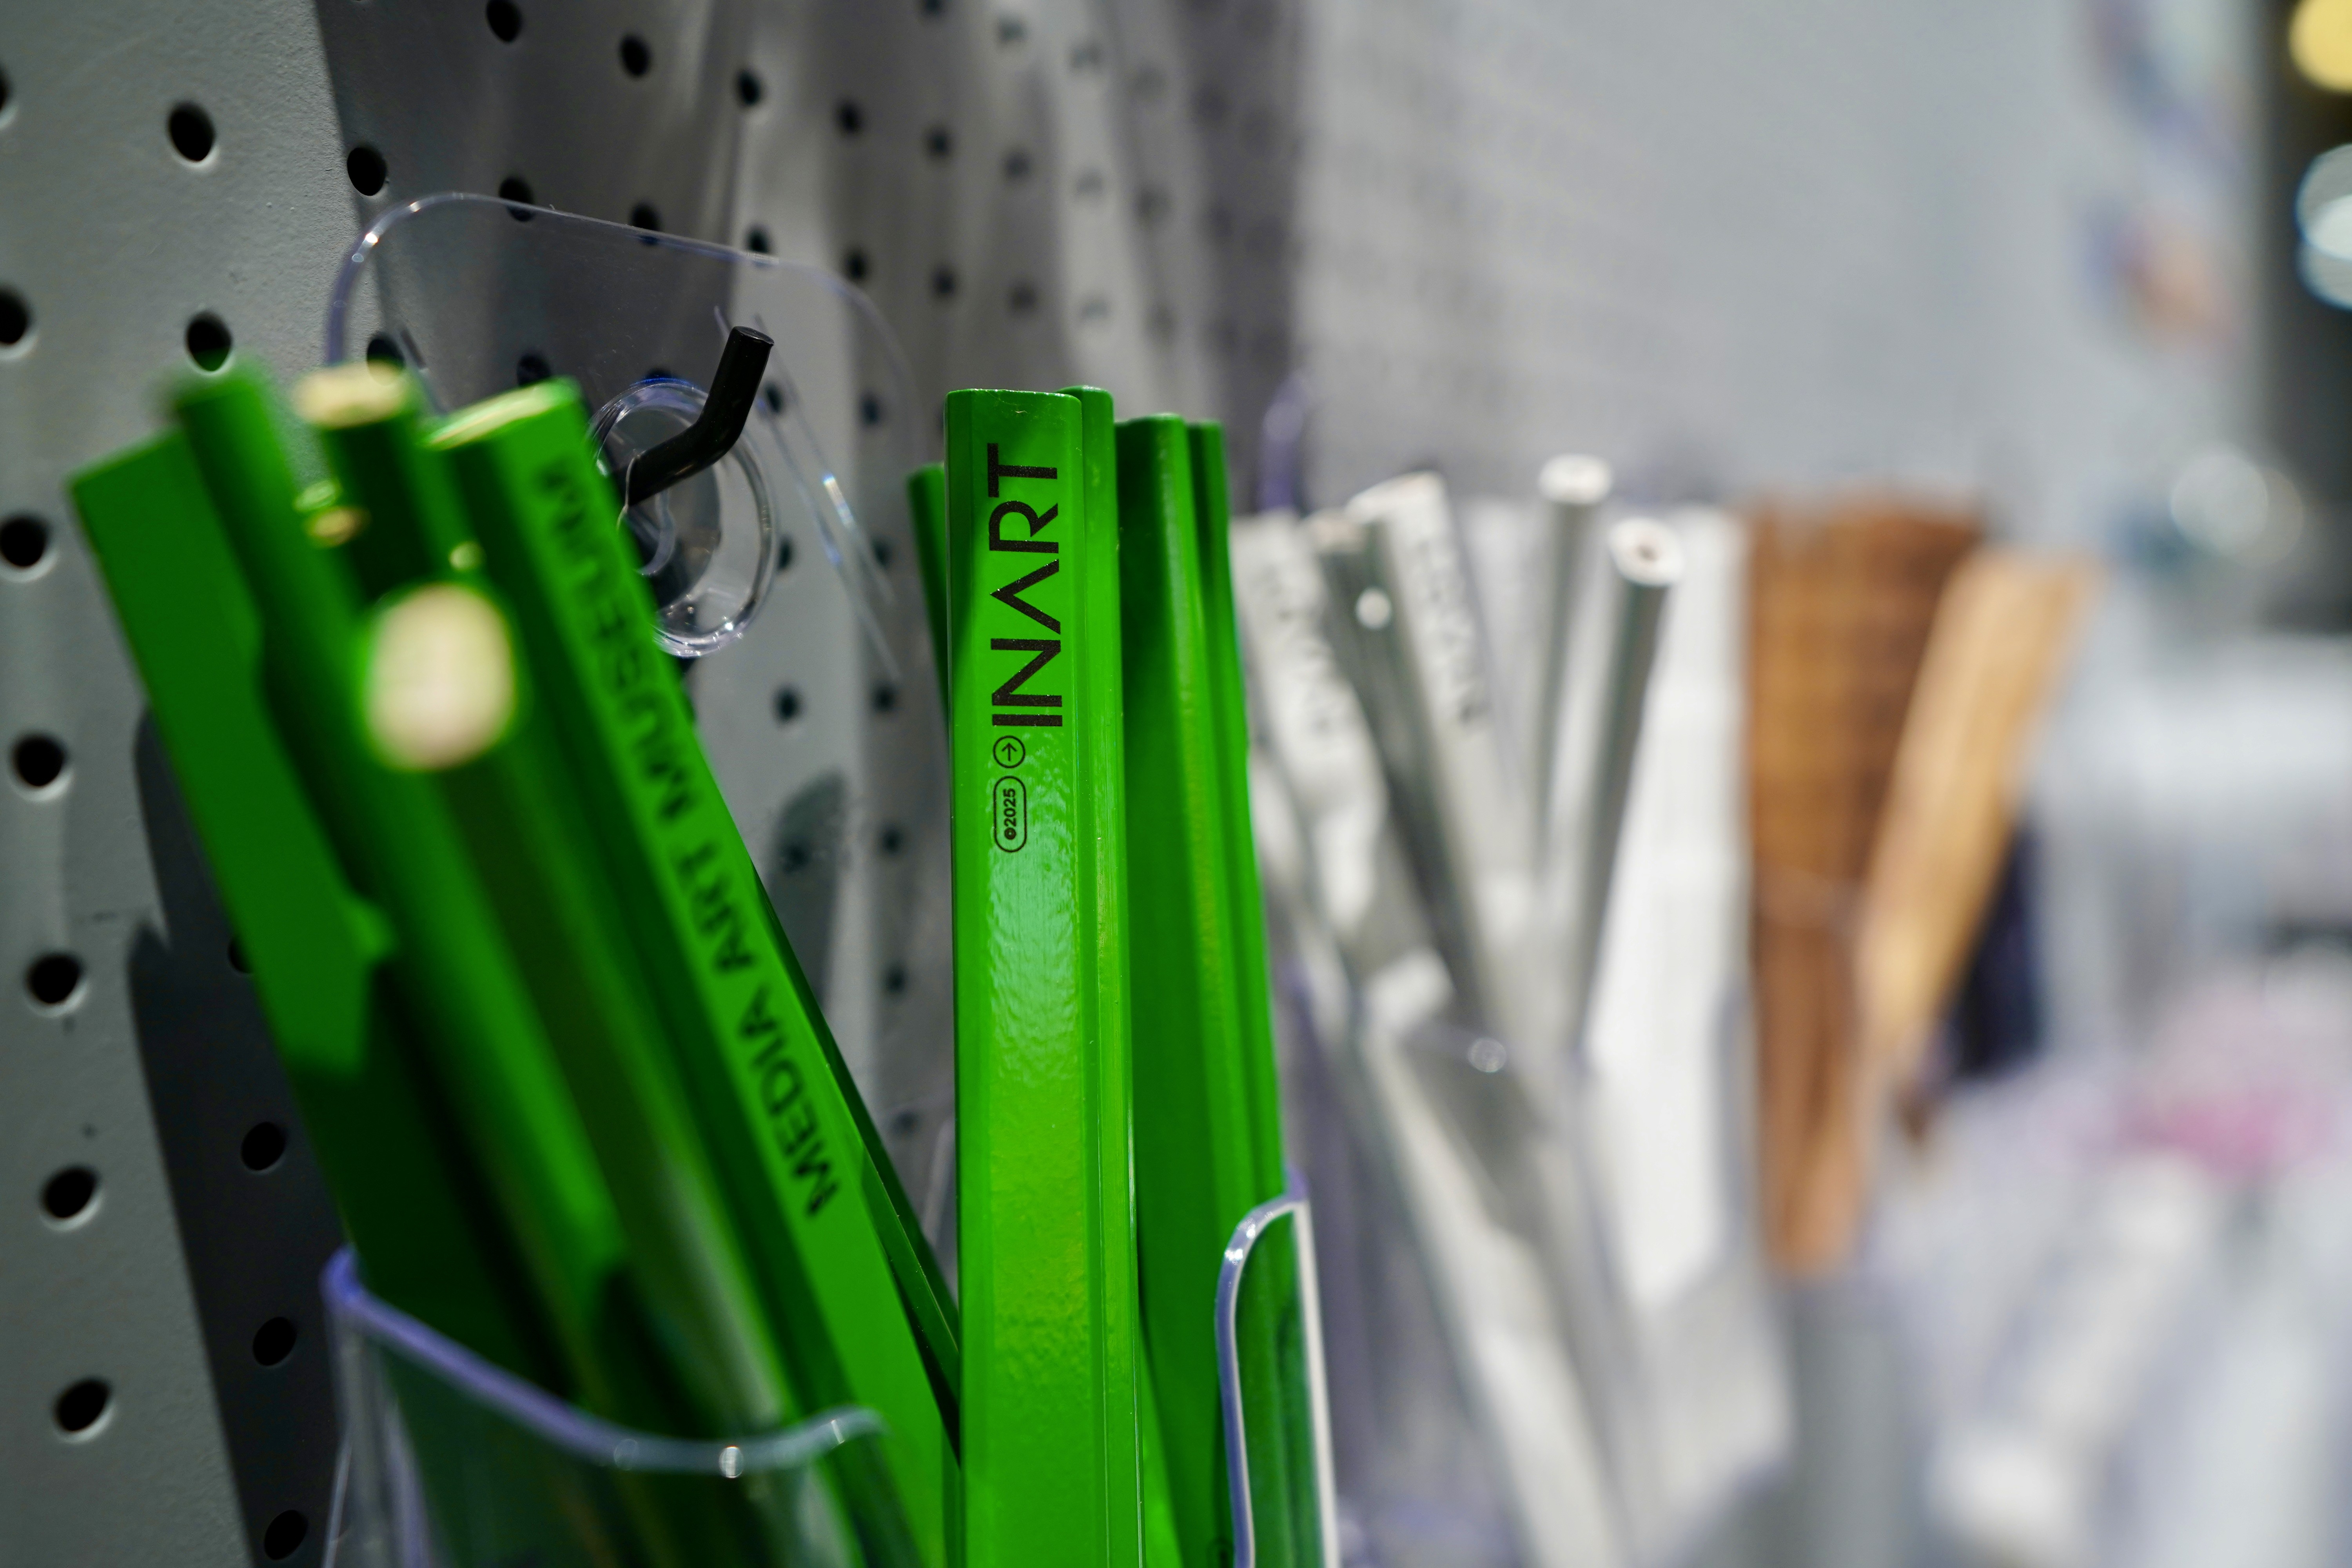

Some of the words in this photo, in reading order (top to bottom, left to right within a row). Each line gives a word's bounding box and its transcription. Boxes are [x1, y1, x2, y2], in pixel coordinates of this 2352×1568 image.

[534, 459, 695, 822] MUSEUM
[668, 837, 757, 973] ART
[739, 985, 838, 1217] MEDIA
